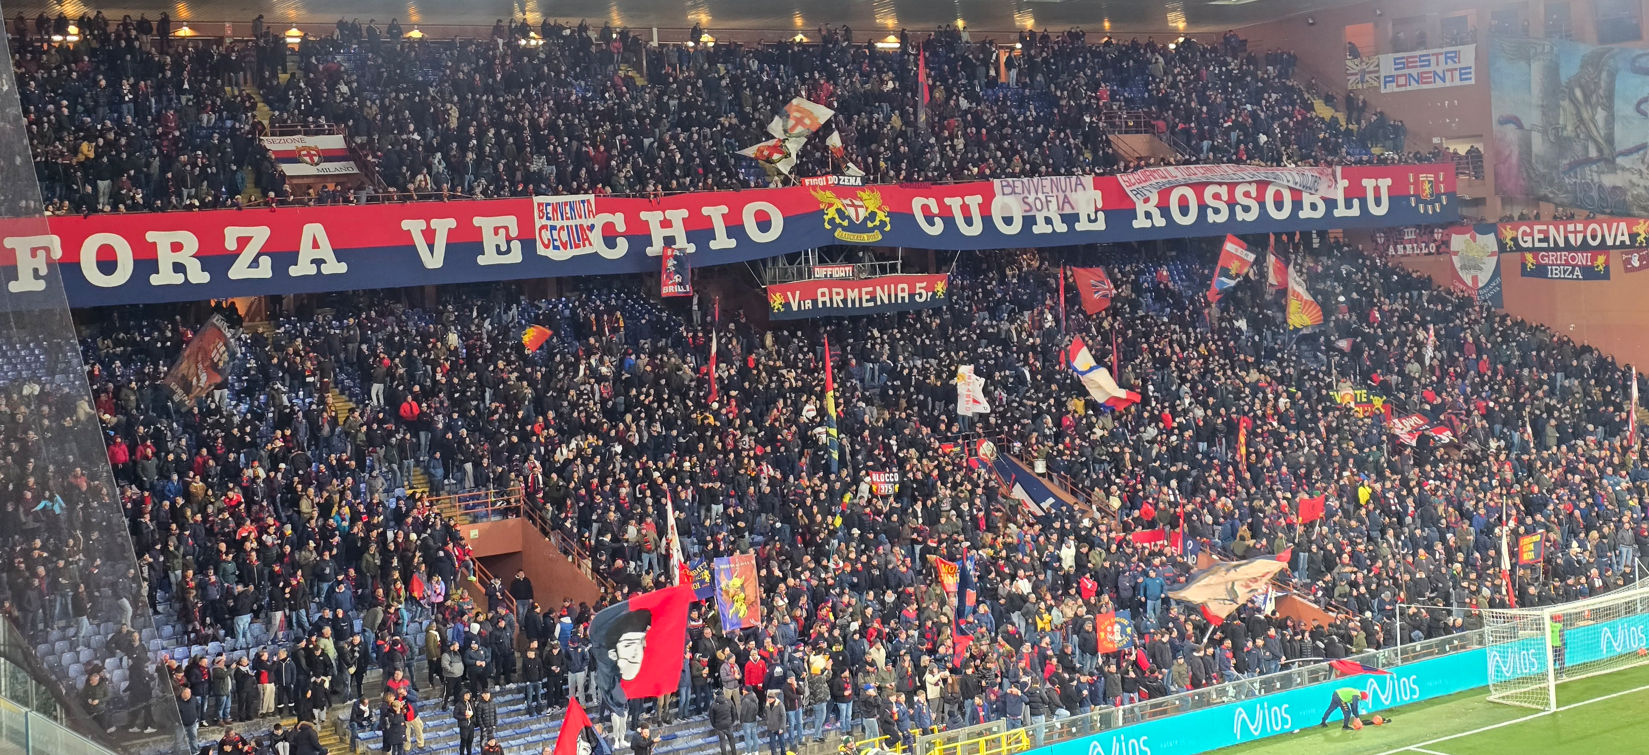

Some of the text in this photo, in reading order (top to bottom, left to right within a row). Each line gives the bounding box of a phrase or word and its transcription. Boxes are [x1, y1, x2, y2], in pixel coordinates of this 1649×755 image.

[1393, 50, 1461, 71] SESTRI
[1383, 66, 1472, 89] PONENTE
[266, 137, 306, 145] SEZIONE
[827, 176, 838, 185] DO
[838, 175, 862, 186] ZENA
[1174, 165, 1197, 177] TUO
[1000, 176, 1086, 196] BENVENUTA
[537, 199, 595, 221] BENVENUTA
[1022, 194, 1075, 213] SOFIA
[3, 223, 347, 293] FORZA
[402, 202, 784, 269] VECHIO
[912, 190, 1106, 237] CUORE
[1132, 178, 1392, 229] ROSSOBLU
[538, 224, 593, 250] CECILIA
[1517, 222, 1631, 248] GENOVA
[1388, 243, 1436, 255] ANELLO
[1538, 253, 1592, 265] GRIFONI
[814, 266, 853, 278] DIFFIDATI
[1547, 266, 1583, 279] IBIZA
[817, 283, 909, 309] ARMENIA
[872, 473, 898, 483] BLOCCO
